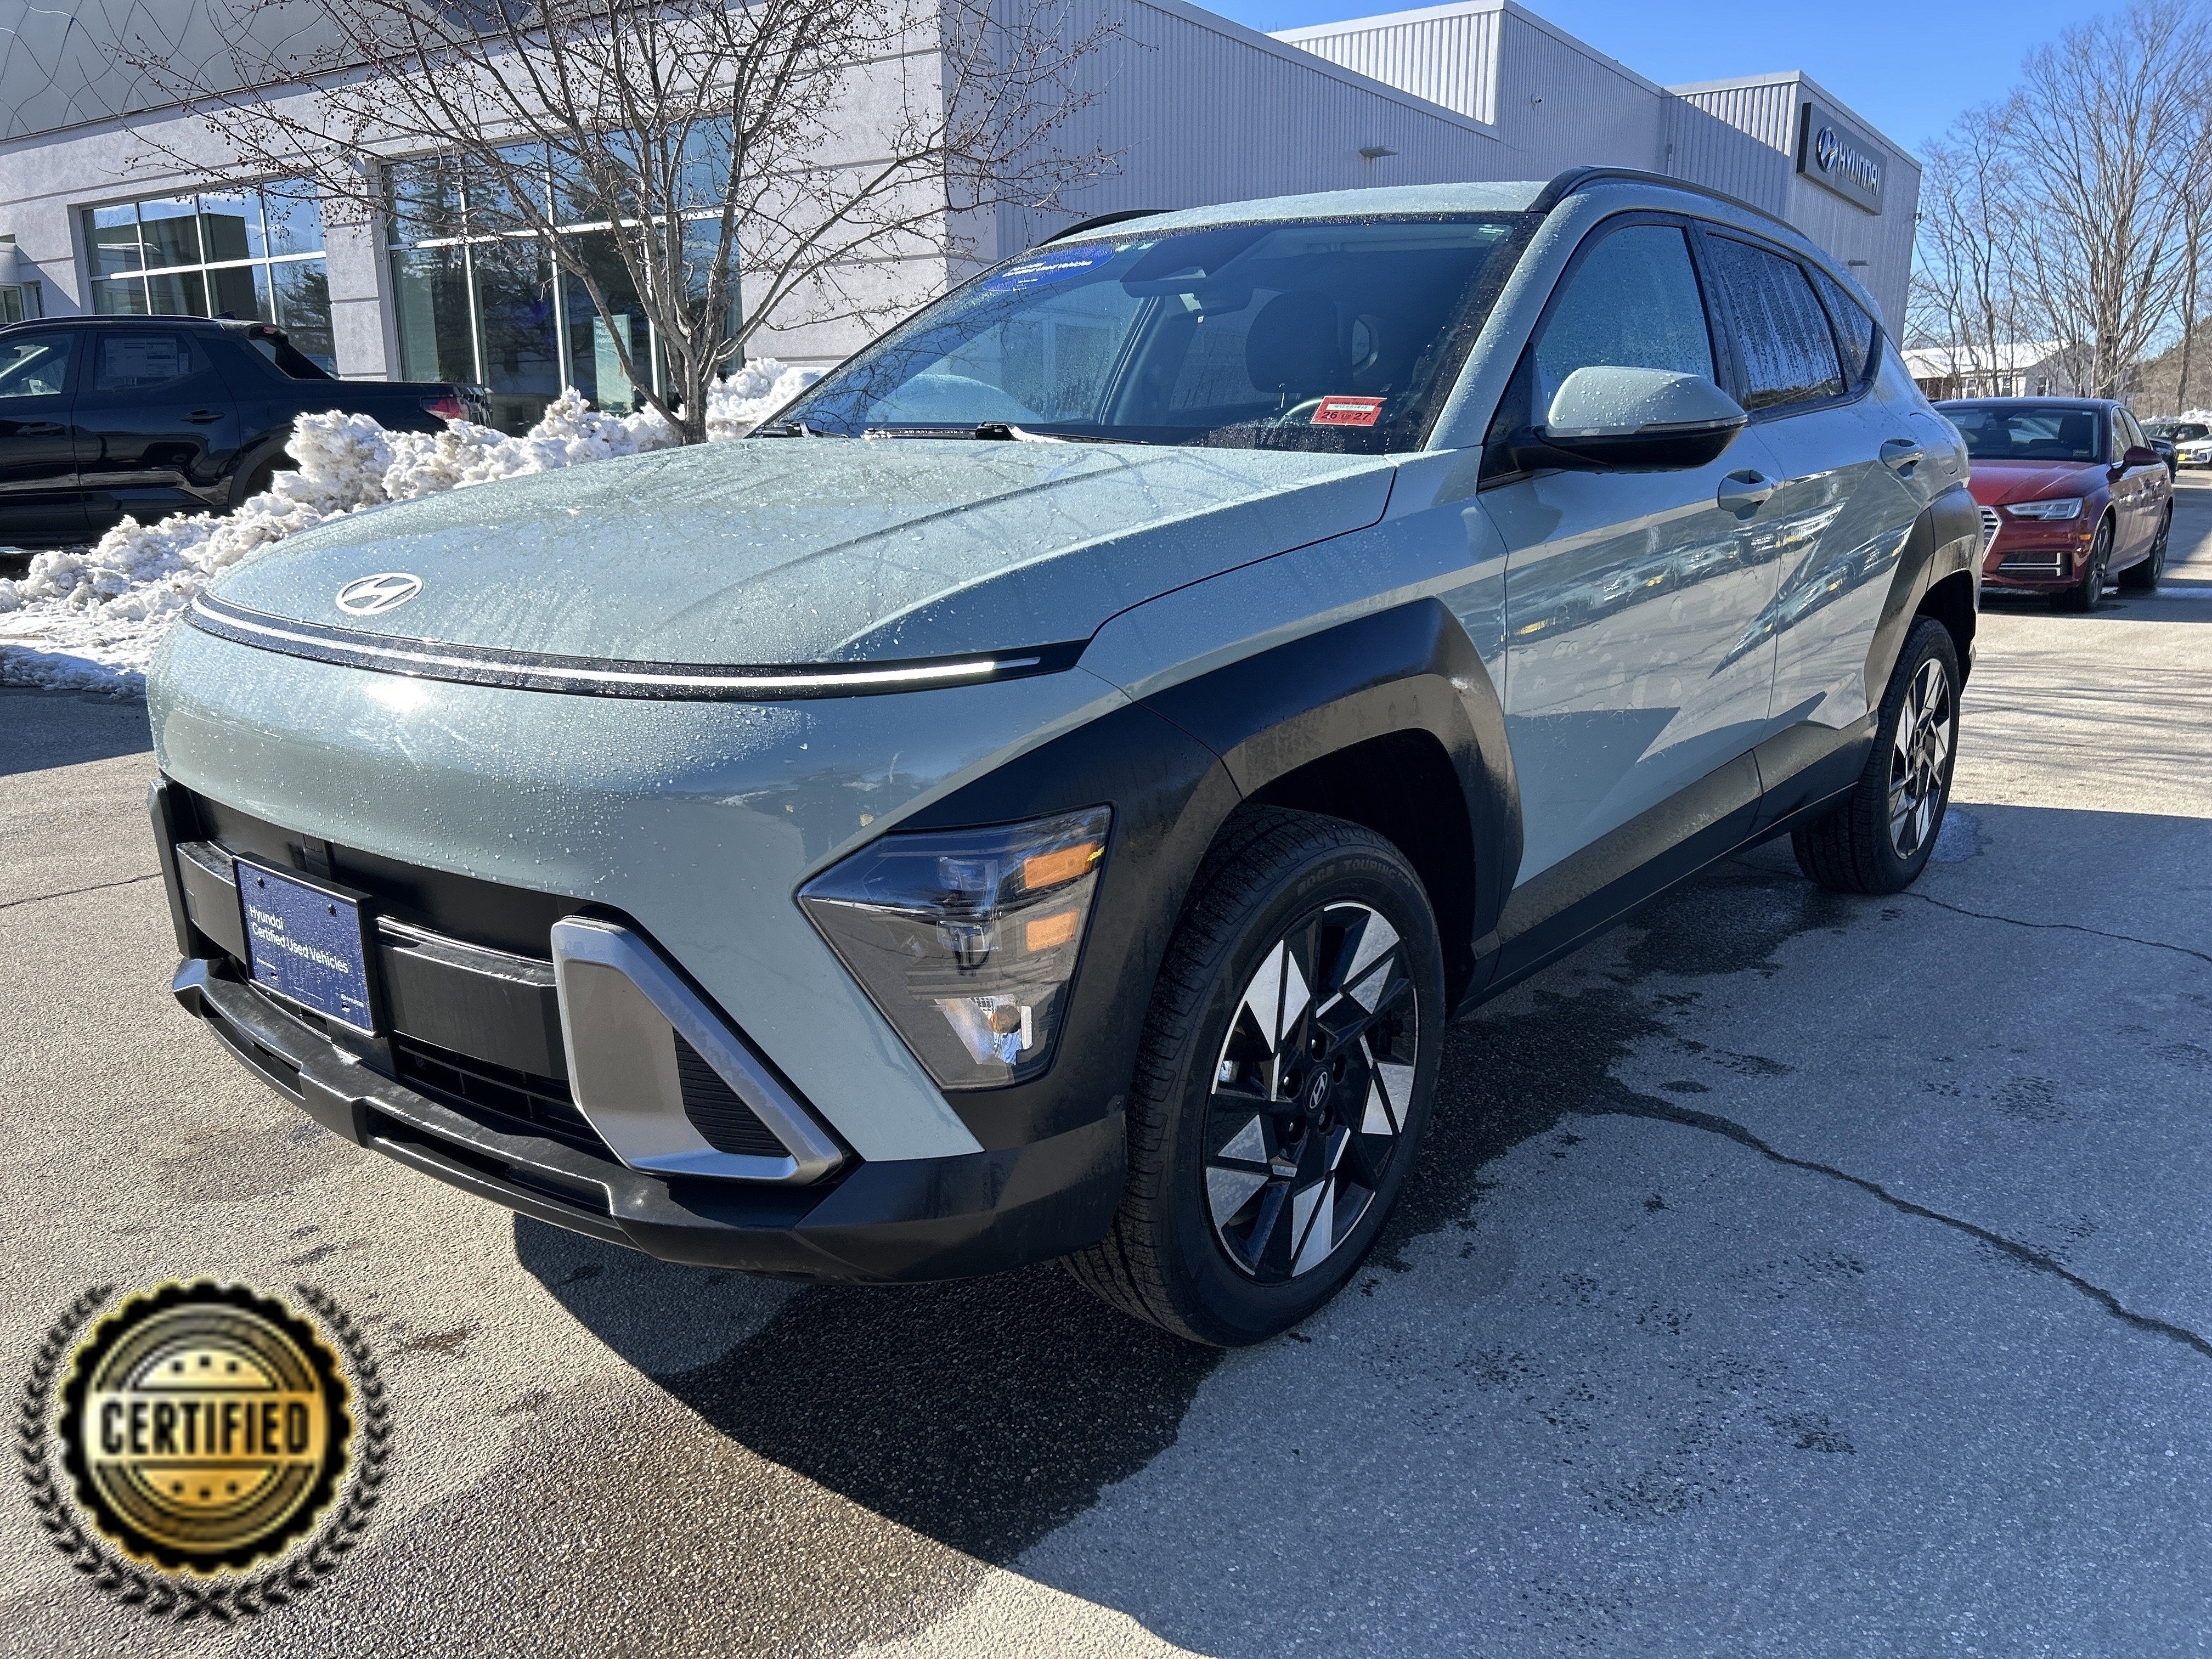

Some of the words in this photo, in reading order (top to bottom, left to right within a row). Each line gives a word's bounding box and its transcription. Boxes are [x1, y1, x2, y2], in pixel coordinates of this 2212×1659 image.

[1837, 141, 1880, 196] HYUNDAI
[250, 905, 284, 930] Hyundai
[252, 922, 286, 948] Certified
[286, 937, 309, 960] Used
[309, 946, 349, 974] Vehicles
